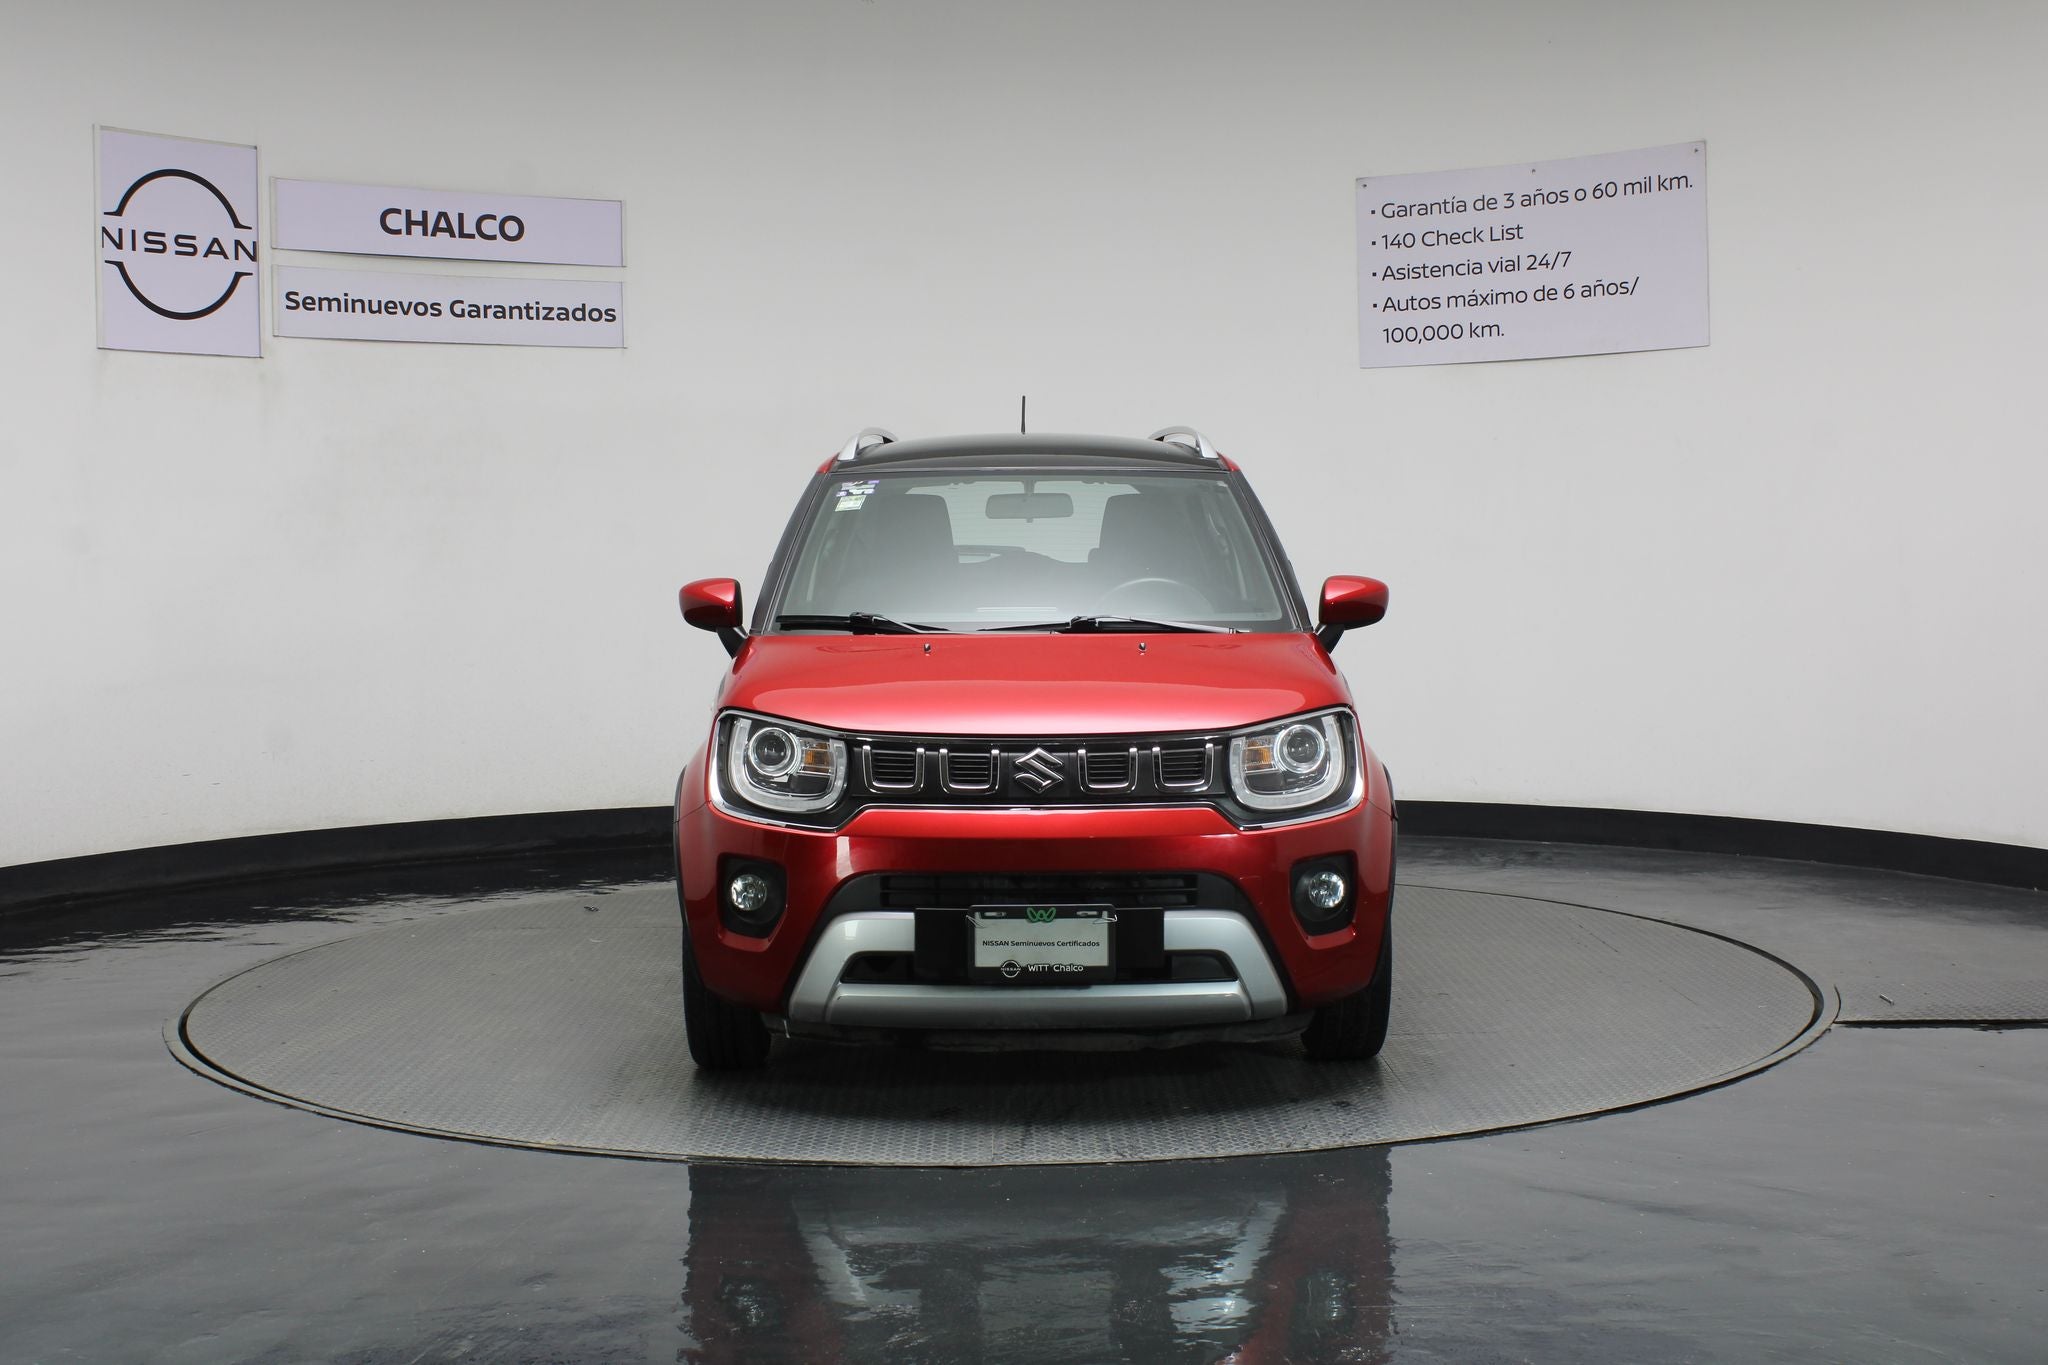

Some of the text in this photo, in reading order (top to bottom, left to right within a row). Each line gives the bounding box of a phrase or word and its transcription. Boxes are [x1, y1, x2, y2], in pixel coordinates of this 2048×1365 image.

[1381, 173, 1693, 219] Garantía de 3 años o 60 mil km.
[379, 207, 525, 243] CHALCO
[1381, 223, 1524, 250] 140 Check List
[101, 225, 258, 262] NISSAN
[1382, 250, 1572, 281] Asistencia vial 24/7
[284, 290, 617, 323] Seminuevos Garantizados
[1382, 276, 1640, 313] Autos máximo de 6 años/
[1382, 321, 1505, 345] 100,000 km.
[1053, 963, 1084, 972] Chalco
